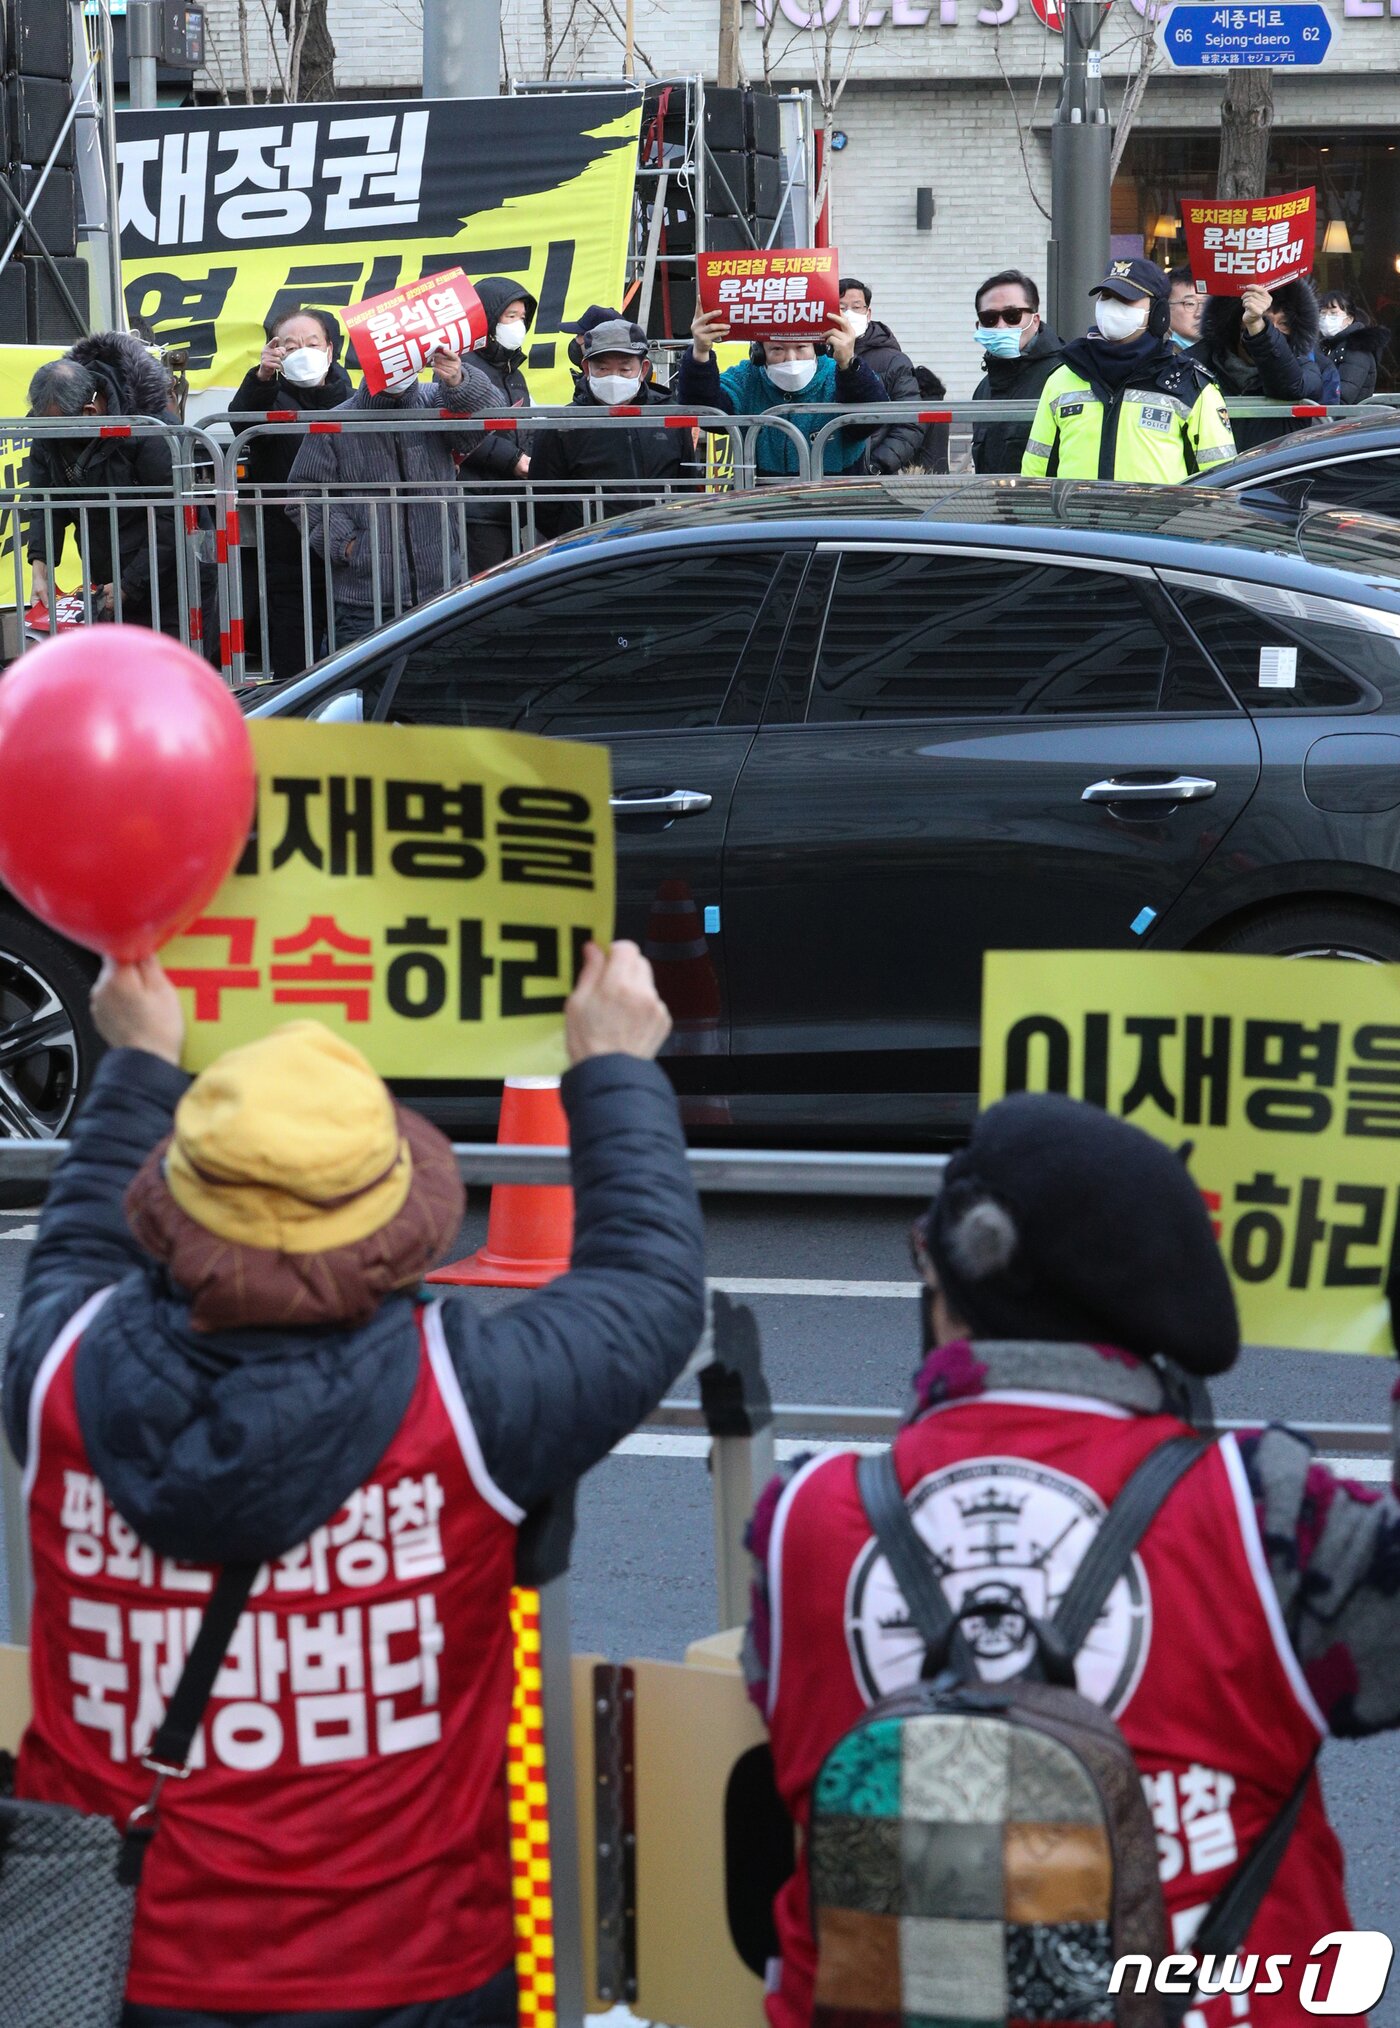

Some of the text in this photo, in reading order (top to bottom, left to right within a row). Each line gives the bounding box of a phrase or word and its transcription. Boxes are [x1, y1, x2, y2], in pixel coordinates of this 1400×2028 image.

[1212, 9, 1284, 29] 세종대로
[1175, 29, 1193, 43] 66
[1205, 33, 1291, 48] Sejong-daero
[1302, 27, 1320, 41] 62
[1201, 54, 1240, 64] 世宗大路
[1247, 53, 1296, 63] セジョンデロ
[116, 110, 430, 246] 재정권
[1190, 196, 1310, 225] 정치검찰 독재정권
[1203, 221, 1290, 251] 윤석열을
[706, 256, 833, 277] 정치검찰 독재정권
[1214, 239, 1304, 275] 타도하자!
[718, 276, 809, 303] 윤석열을
[367, 287, 467, 350] 윤석열
[729, 301, 825, 324] 타도하자!
[1141, 419, 1168, 430] POLICE
